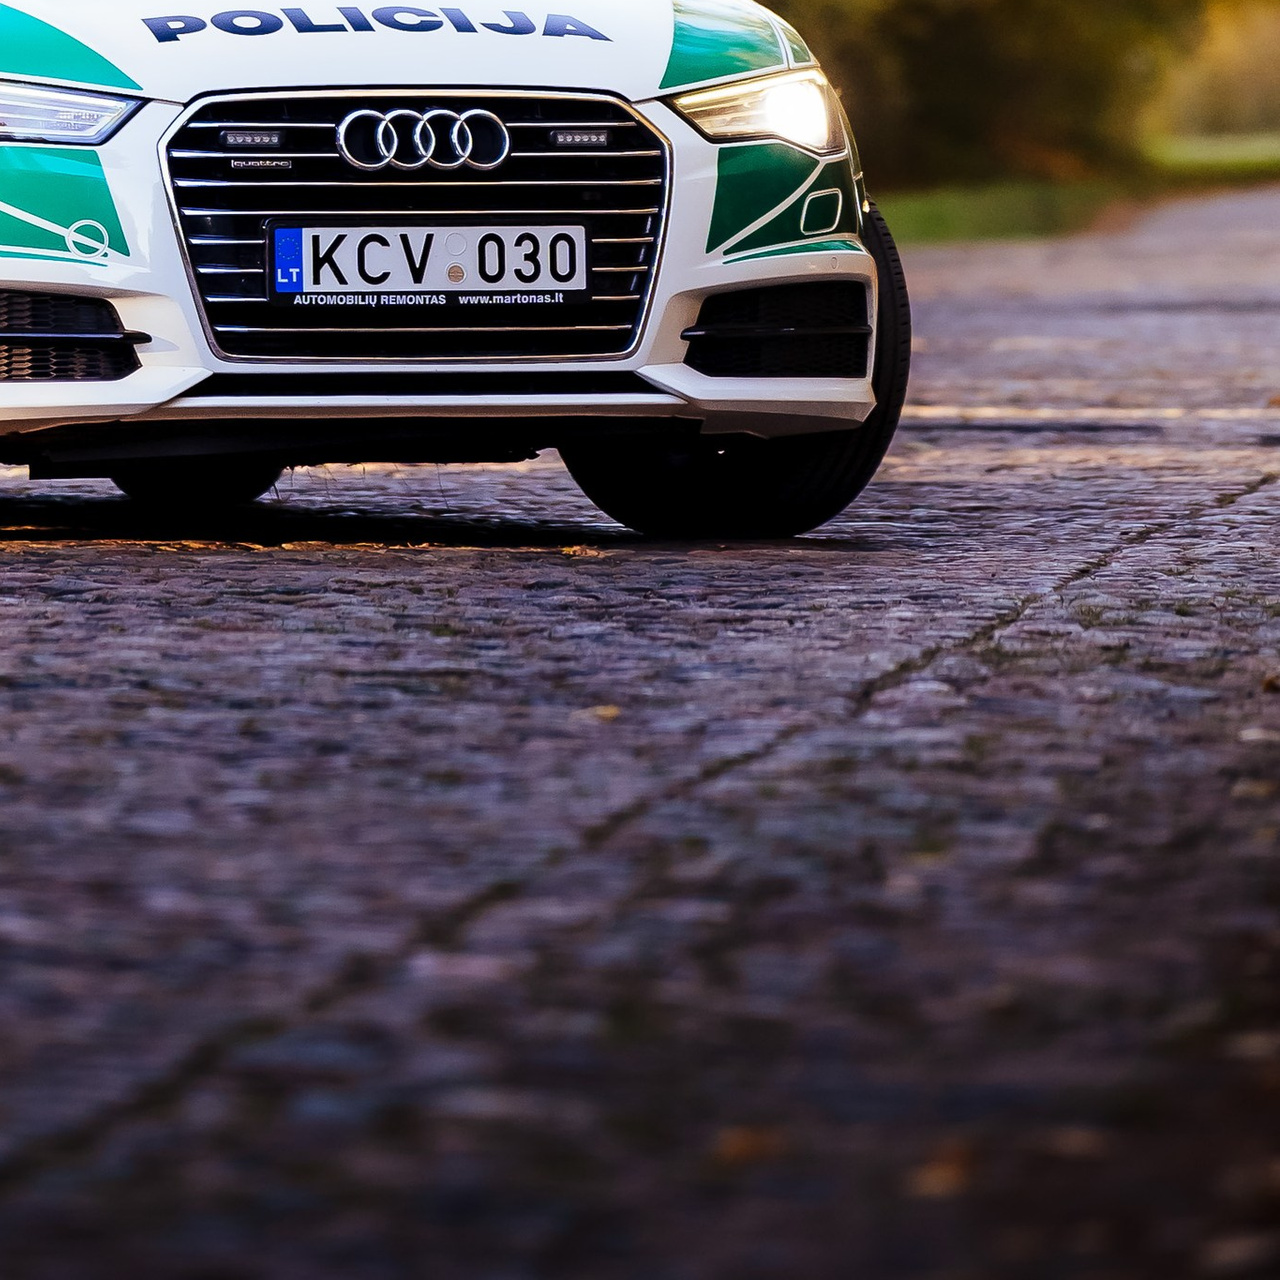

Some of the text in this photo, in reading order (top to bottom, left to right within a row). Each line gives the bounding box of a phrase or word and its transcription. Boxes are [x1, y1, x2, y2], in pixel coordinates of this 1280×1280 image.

[140, 6, 614, 43] POLICIJA
[311, 232, 577, 286] KCV 030
[277, 268, 300, 283] LT
[294, 293, 564, 308] AUTOMOBILIŲ REMONTAS www.martonas.lt
